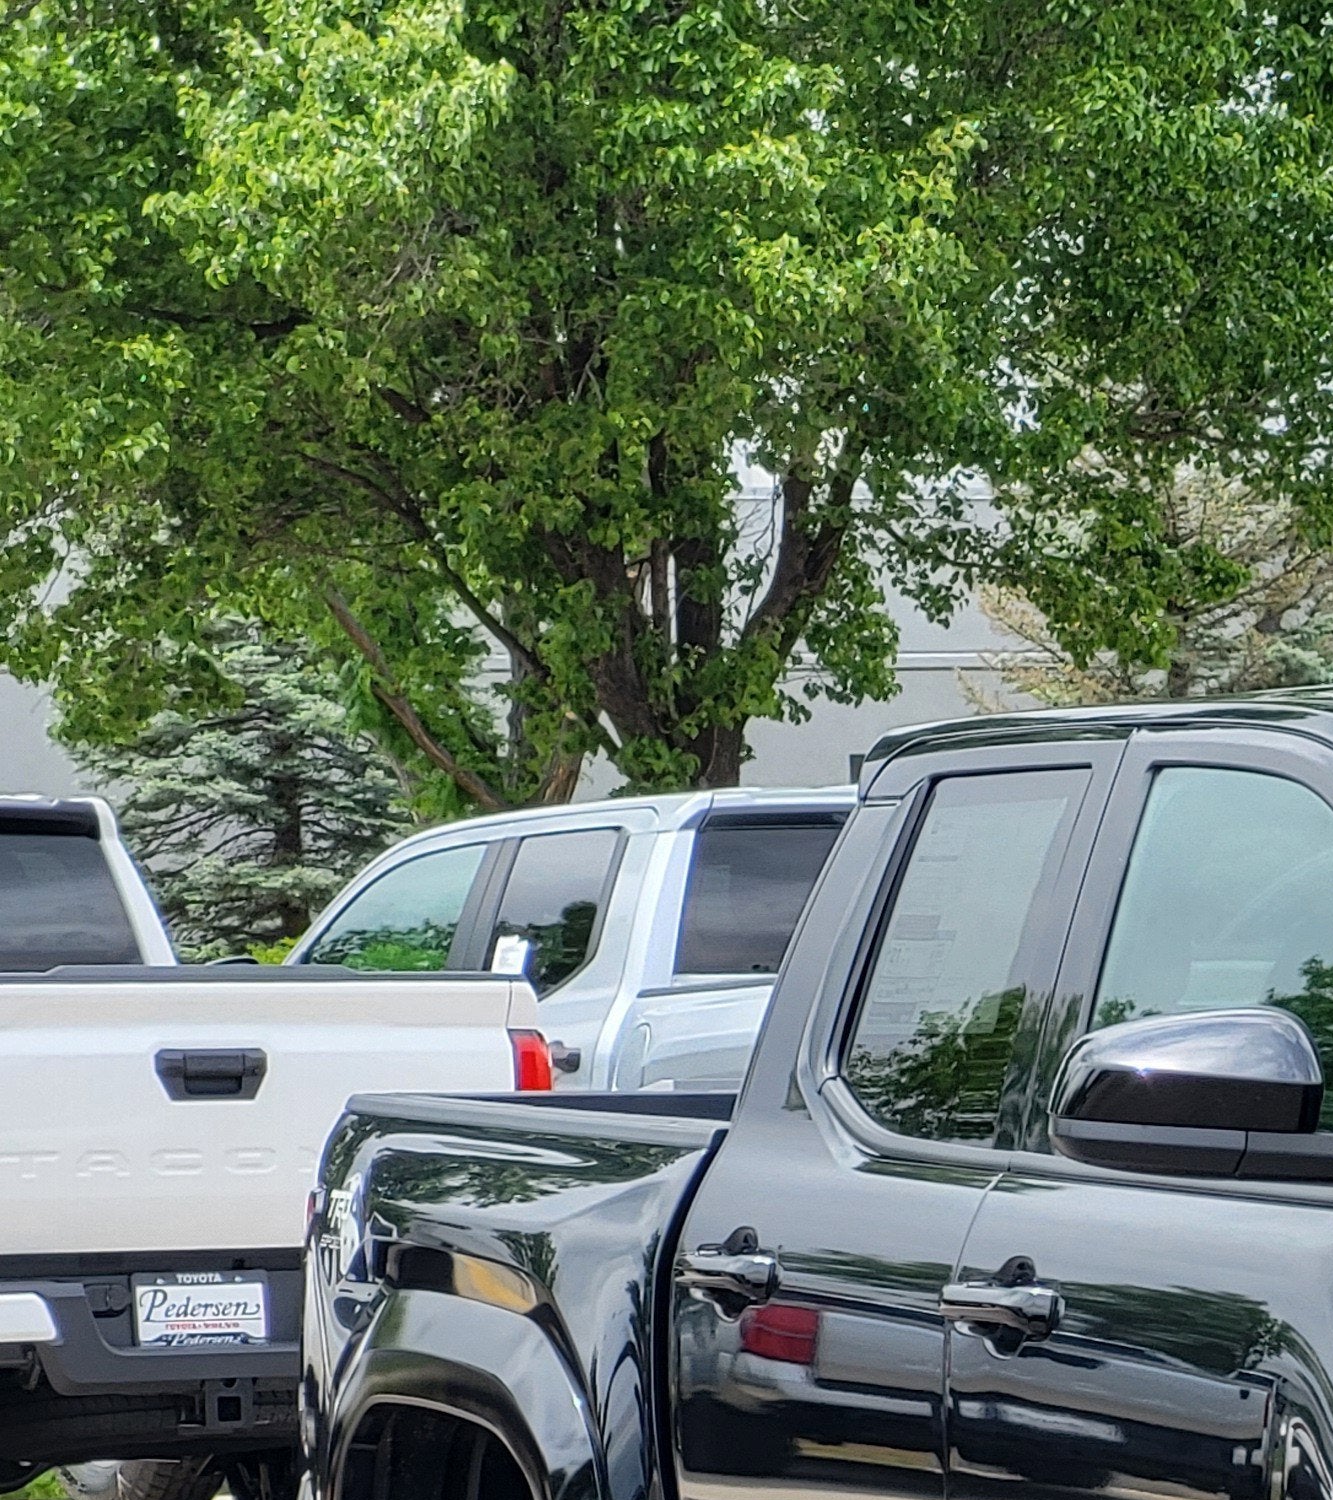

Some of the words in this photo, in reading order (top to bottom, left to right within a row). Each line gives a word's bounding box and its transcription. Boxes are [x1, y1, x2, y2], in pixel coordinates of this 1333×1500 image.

[0, 1147, 318, 1179] TACO
[175, 1273, 222, 1284] TOYOTA
[139, 1288, 261, 1323] Pedersen
